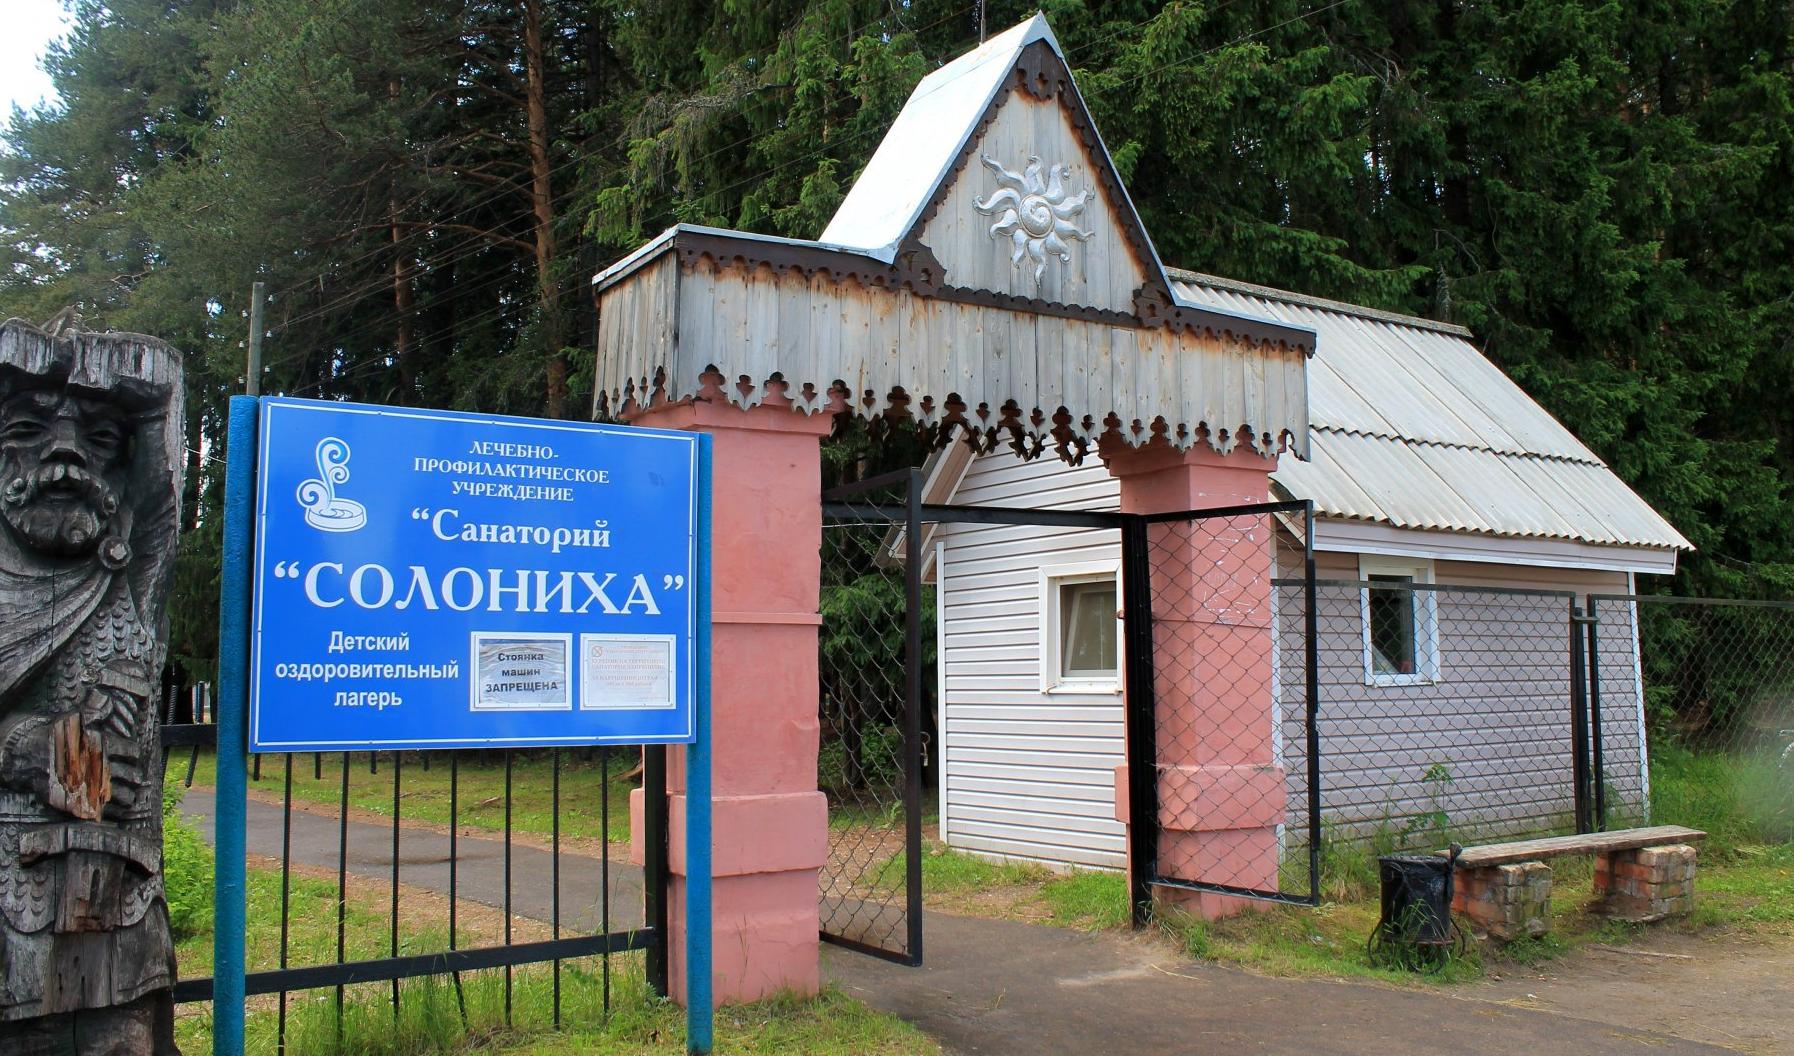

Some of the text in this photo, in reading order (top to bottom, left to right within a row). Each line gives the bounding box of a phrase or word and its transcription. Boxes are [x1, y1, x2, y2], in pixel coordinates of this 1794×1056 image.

[469, 440, 559, 460] ЛЕЧЕБНО-
[413, 457, 610, 484] ПРОФИЛАКТИЧЕСКОЕ
[452, 481, 575, 502] УЧРЕЖДЕНИЕ
[328, 631, 410, 654] Детский
[497, 652, 544, 662] Стоянка
[275, 661, 459, 683] оздоровительный
[502, 668, 541, 676] машин
[486, 681, 558, 693] ЗАПРЕЩЕНА
[334, 691, 403, 711] лагерь
